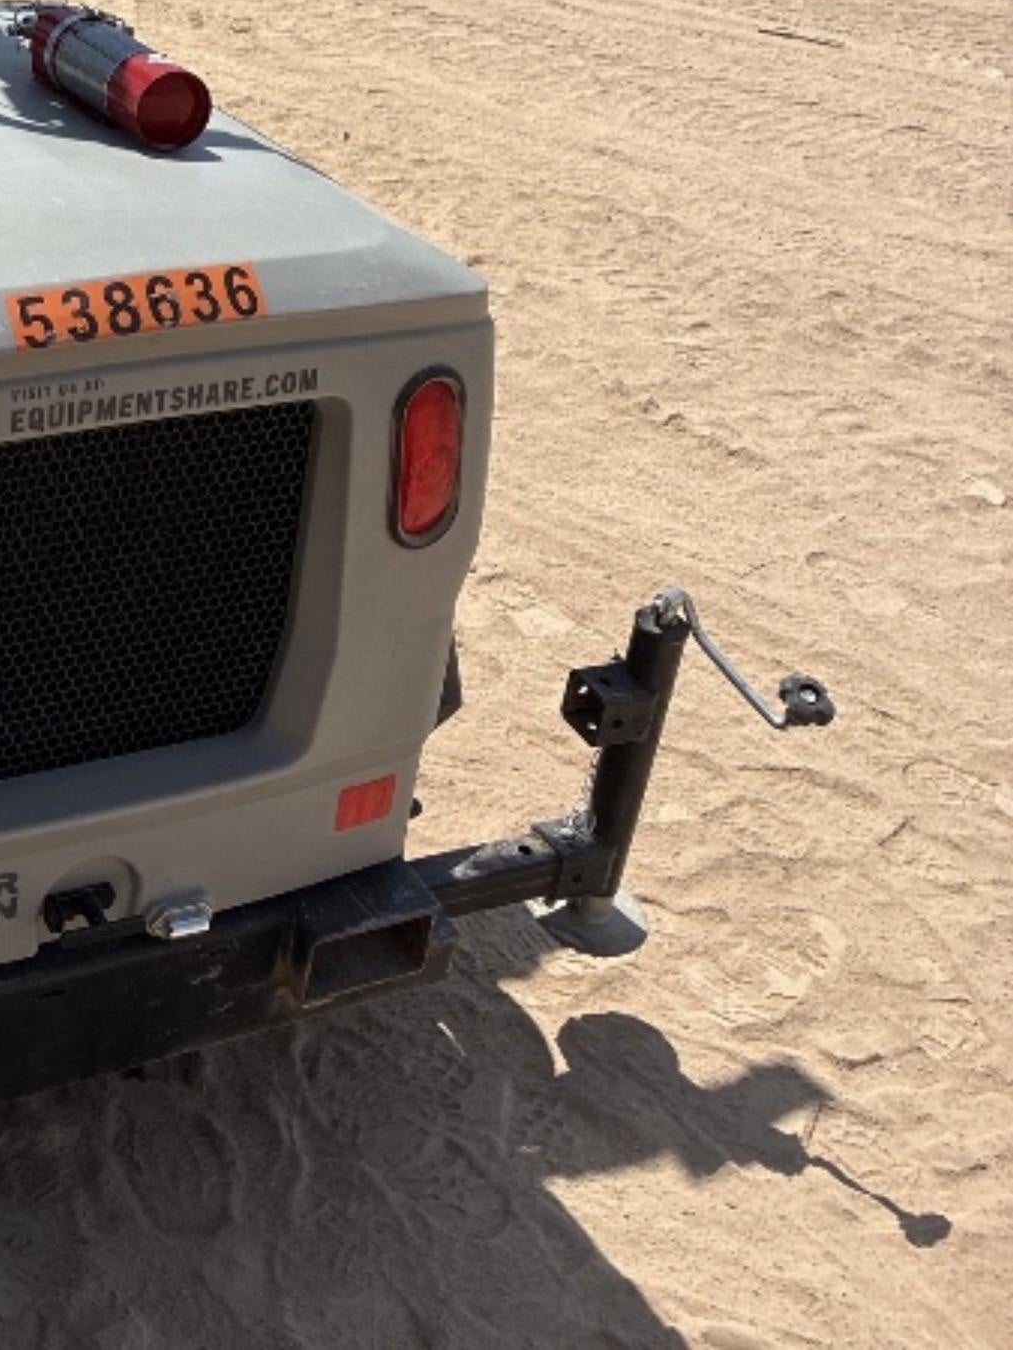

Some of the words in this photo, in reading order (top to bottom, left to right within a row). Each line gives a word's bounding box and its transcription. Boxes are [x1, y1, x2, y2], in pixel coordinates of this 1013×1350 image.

[17, 265, 261, 351] 538636
[10, 385, 52, 402] VISIT
[10, 368, 319, 434] EQUIPMENTSHARE.COM
